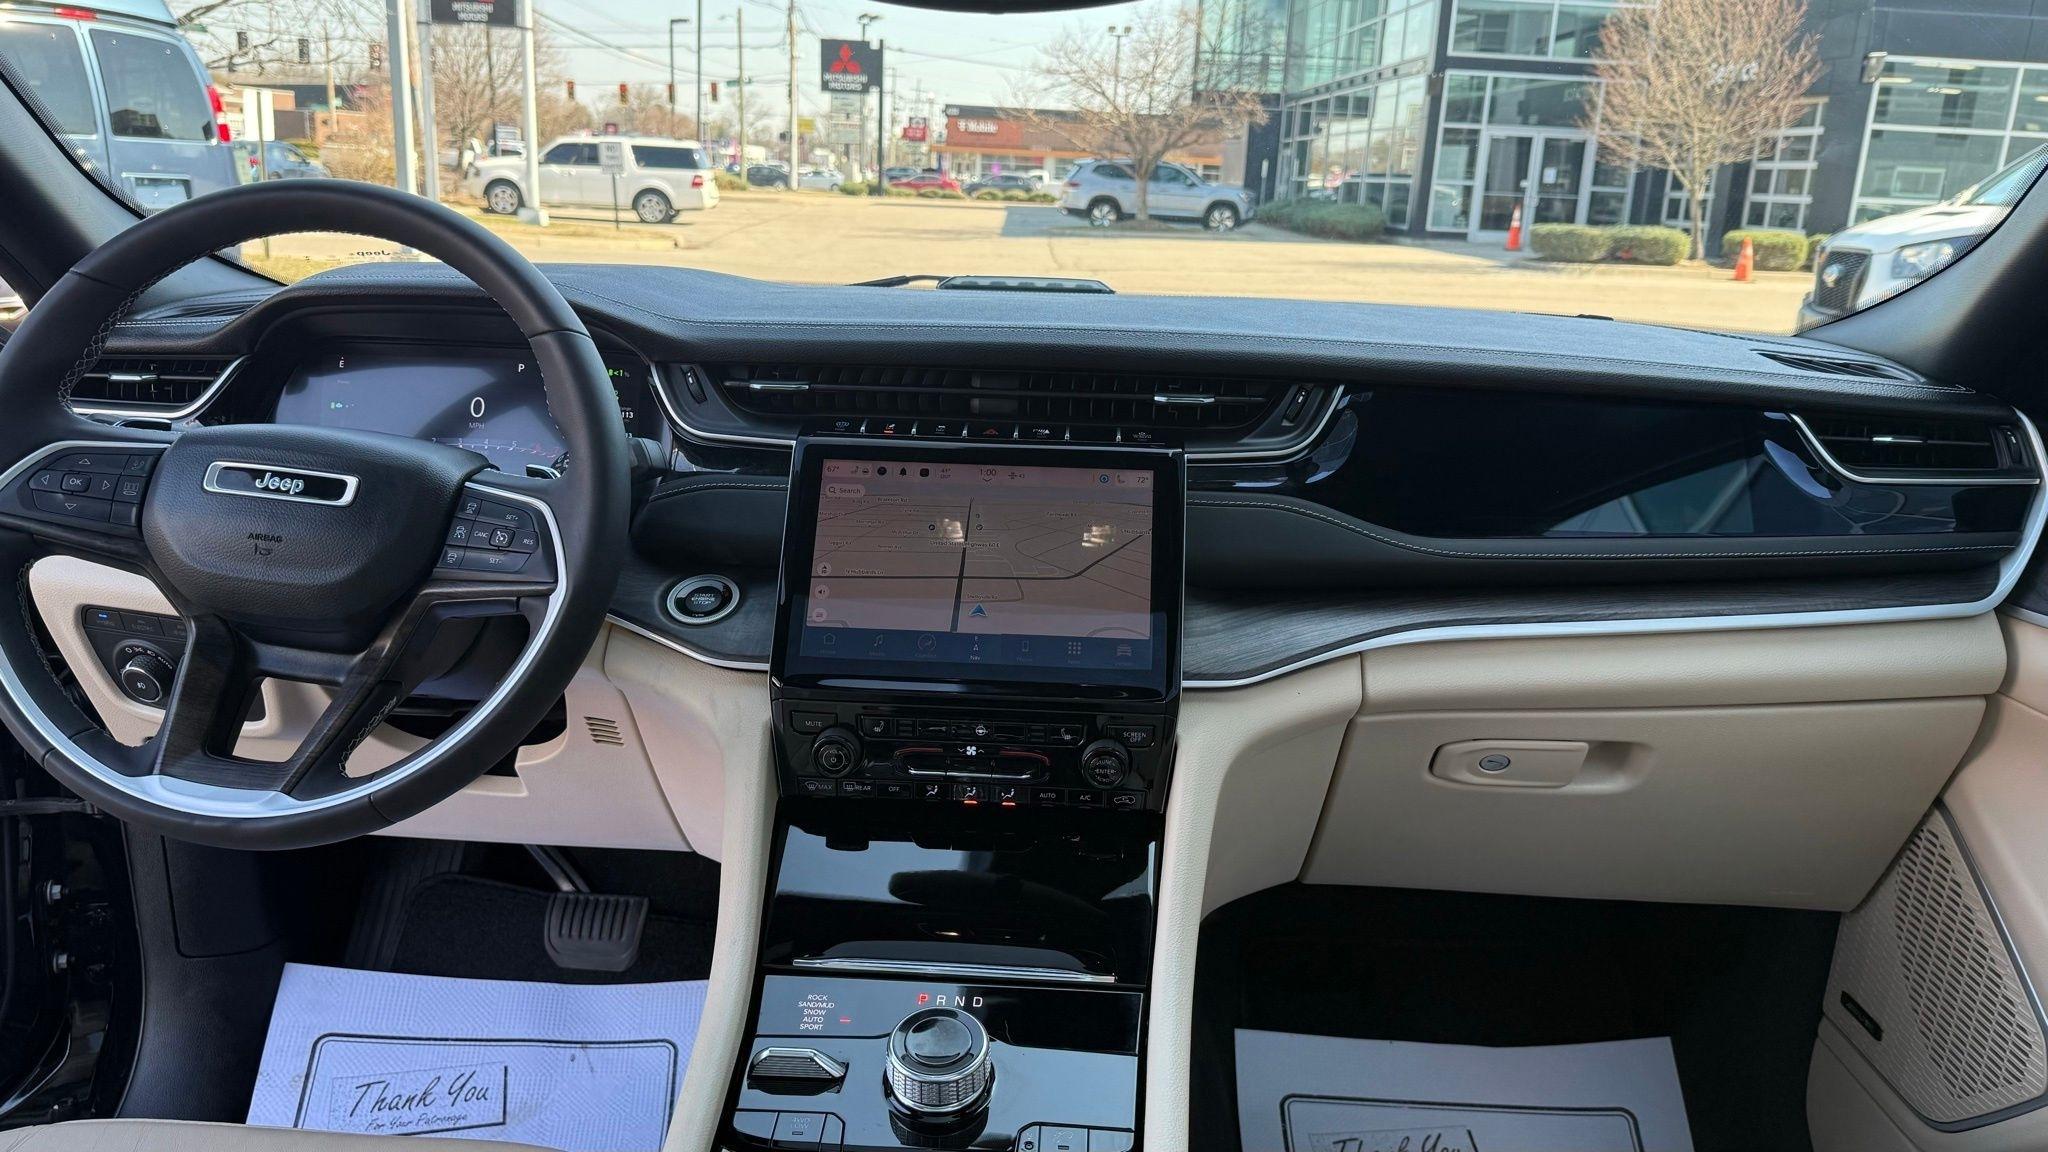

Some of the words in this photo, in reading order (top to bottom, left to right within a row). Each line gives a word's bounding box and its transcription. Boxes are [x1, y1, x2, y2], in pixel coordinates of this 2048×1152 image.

[518, 364, 525, 372] P
[470, 397, 485, 418] 0
[979, 468, 997, 477] 1:00
[69, 478, 82, 486] OK
[255, 472, 305, 495] Jeep
[247, 532, 283, 543] AIRBAG
[1123, 731, 1147, 740] SCREEN
[798, 1001, 835, 1009] SAND/MUD
[917, 993, 929, 1006] P
[936, 994, 946, 1005] R
[954, 995, 966, 1008] N
[972, 996, 984, 1008] D
[803, 1008, 827, 1016] SNOW
[799, 1023, 824, 1031] SPORT
[349, 1075, 442, 1118] Thank
[447, 1070, 489, 1108] You
[365, 1117, 386, 1132] For
[389, 1115, 413, 1129] Your
